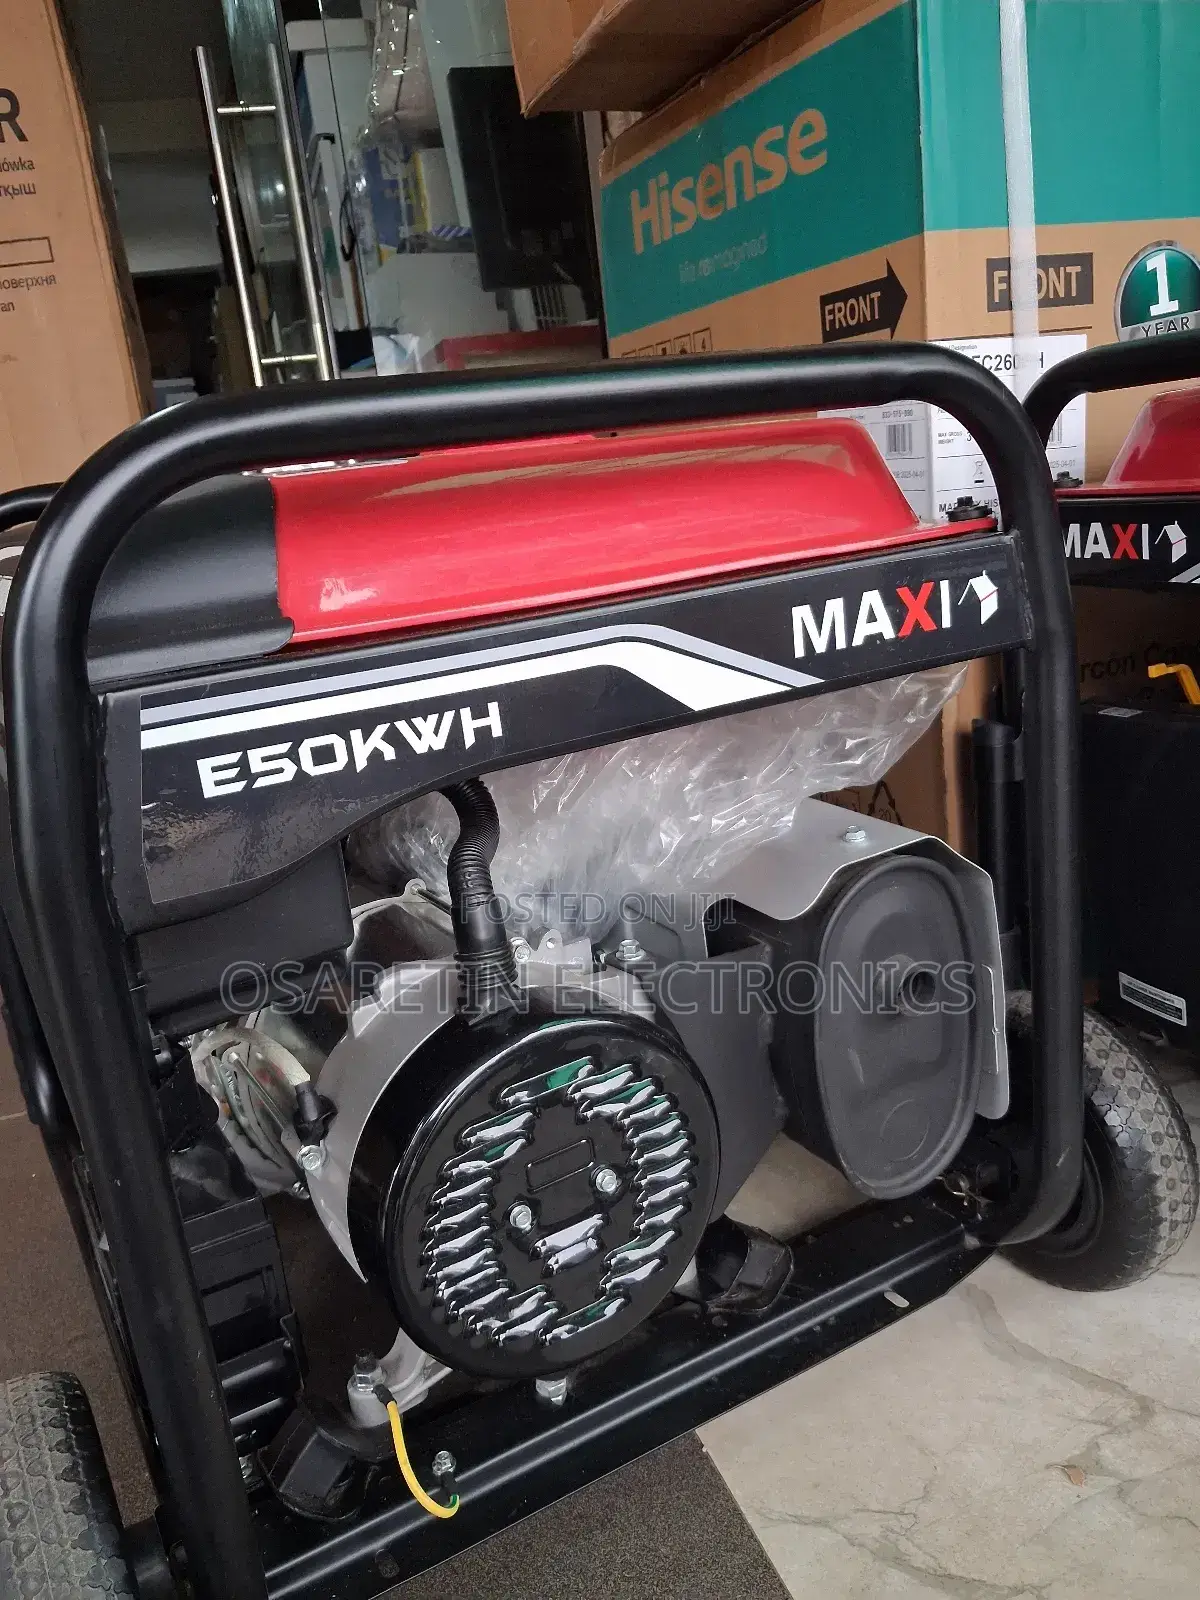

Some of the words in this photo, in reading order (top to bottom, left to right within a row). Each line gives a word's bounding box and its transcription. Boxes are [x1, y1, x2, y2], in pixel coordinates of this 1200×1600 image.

[0, 157, 36, 173] ówka
[630, 108, 828, 255] Hisense
[993, 265, 1082, 303] FONT
[1146, 251, 1179, 317] 1
[824, 291, 881, 332] FRONT
[1062, 522, 1150, 560] MAXI
[791, 579, 952, 659] MAXI
[196, 701, 503, 799] E50KWH
